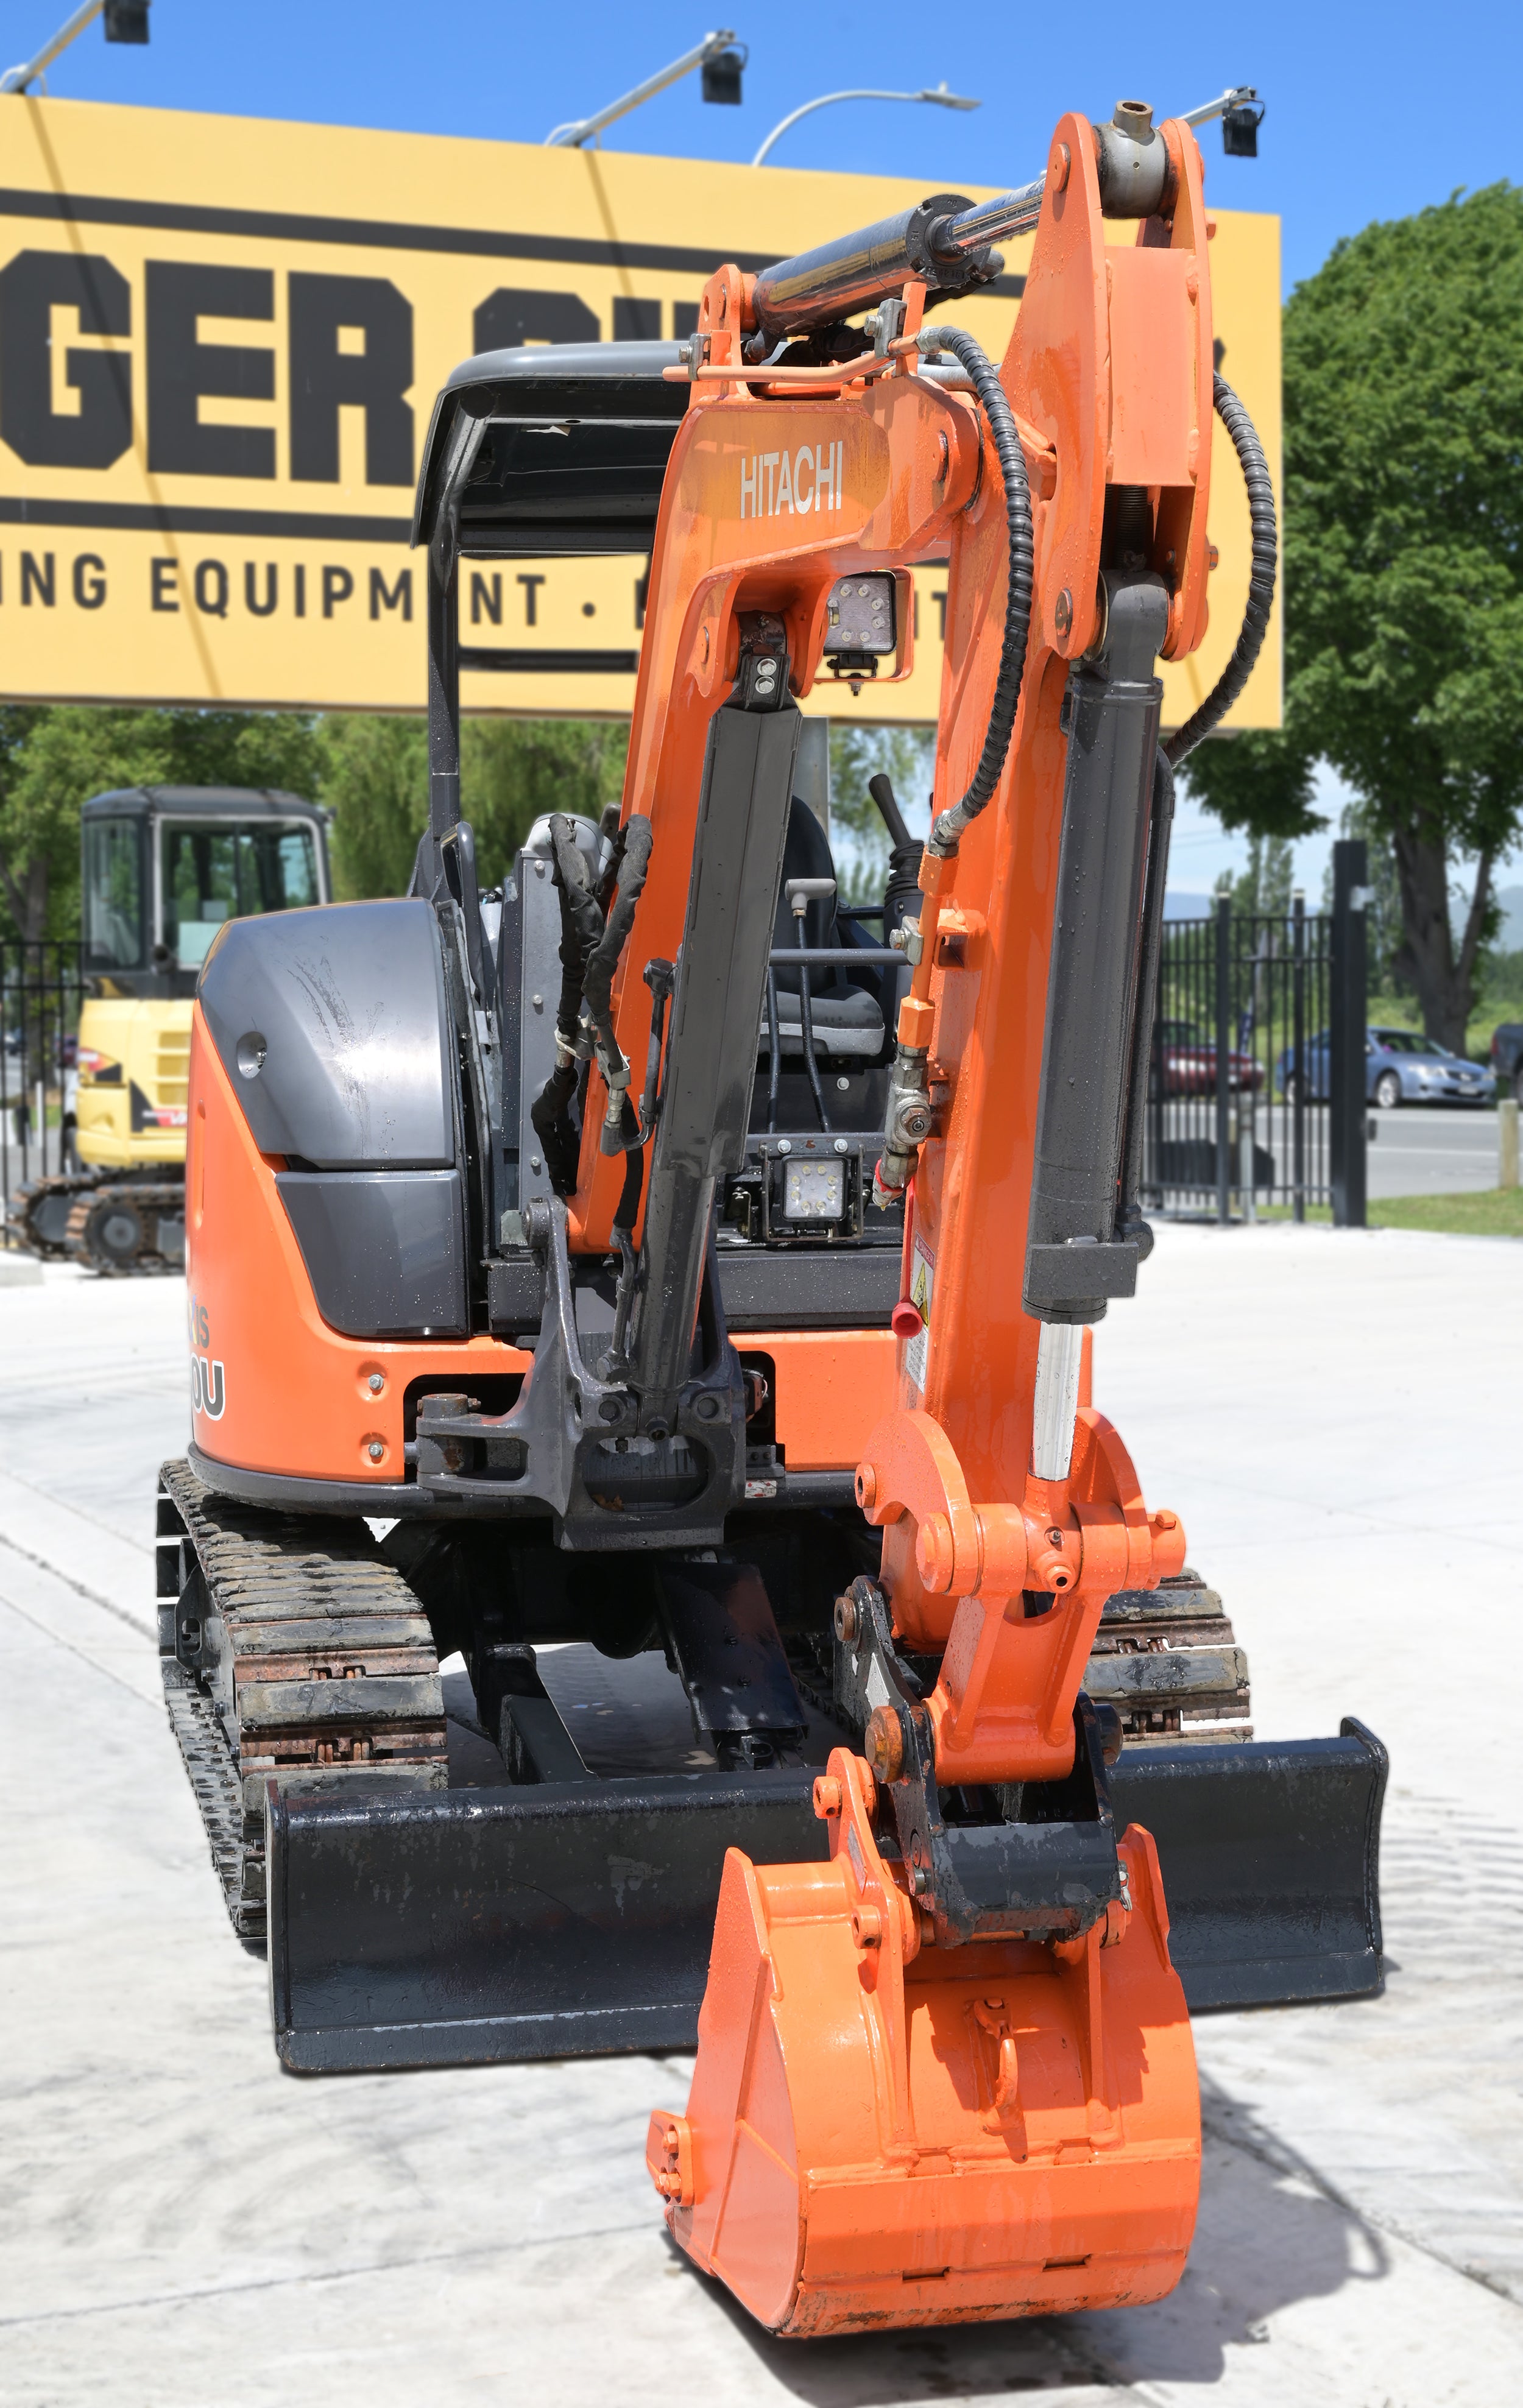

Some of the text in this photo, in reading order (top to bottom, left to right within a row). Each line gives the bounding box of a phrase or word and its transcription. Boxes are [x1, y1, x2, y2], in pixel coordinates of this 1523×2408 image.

[741, 440, 843, 518] HITACHI
[0, 549, 545, 627] NG EQUIPMNT
